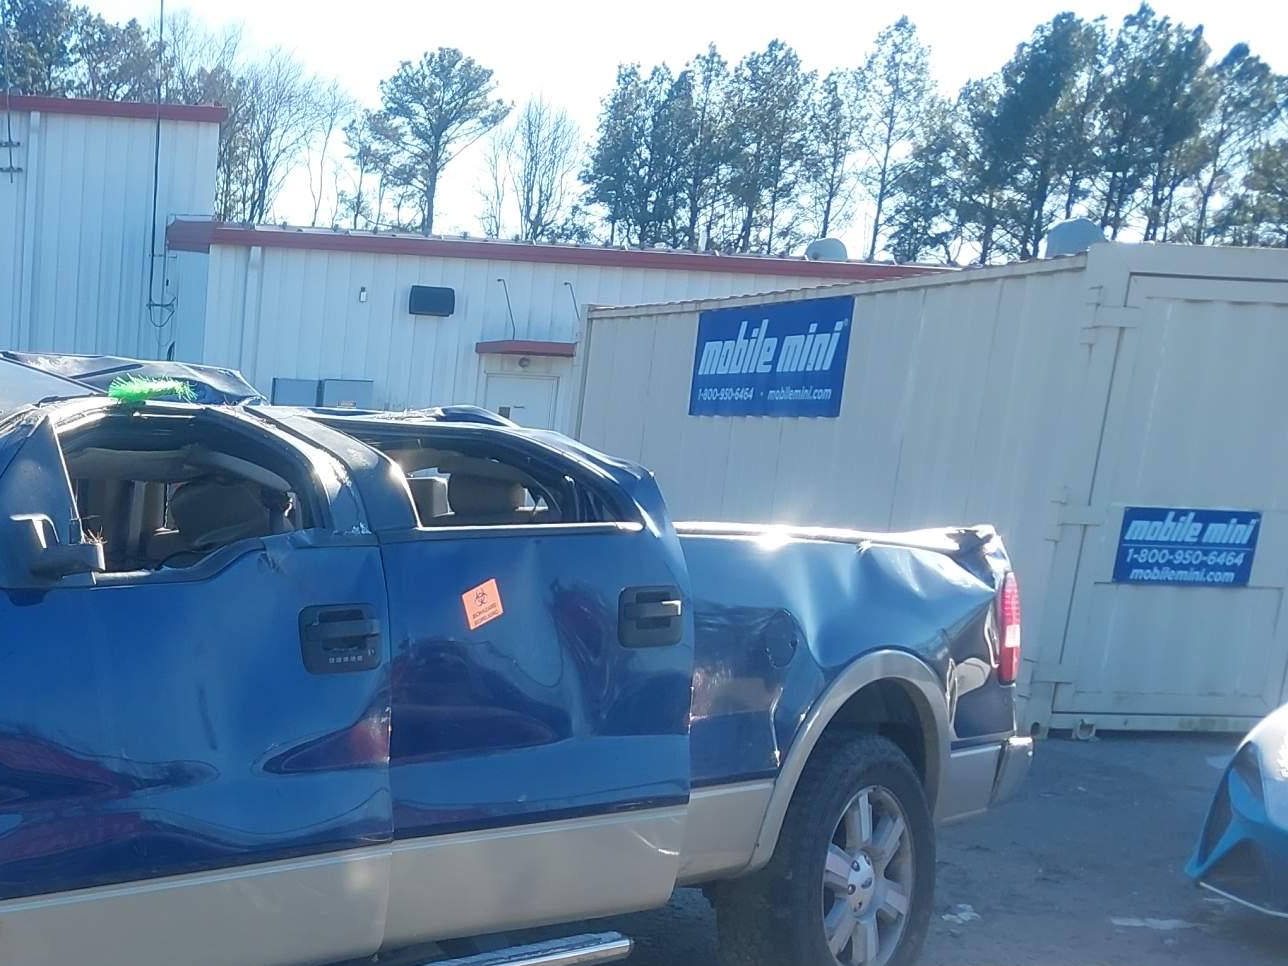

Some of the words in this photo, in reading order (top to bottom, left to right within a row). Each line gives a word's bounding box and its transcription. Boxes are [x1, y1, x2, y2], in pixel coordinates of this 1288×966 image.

[698, 319, 778, 375] mobile
[776, 320, 842, 373] mini
[698, 387, 754, 401] 1-800-950-6464
[767, 385, 832, 401] mobilemini.com
[1124, 511, 1203, 543] mobile
[1202, 518, 1258, 545] mini
[1126, 548, 1245, 567] 1-800-950-6464
[1129, 567, 1235, 583] mobilemini.com
